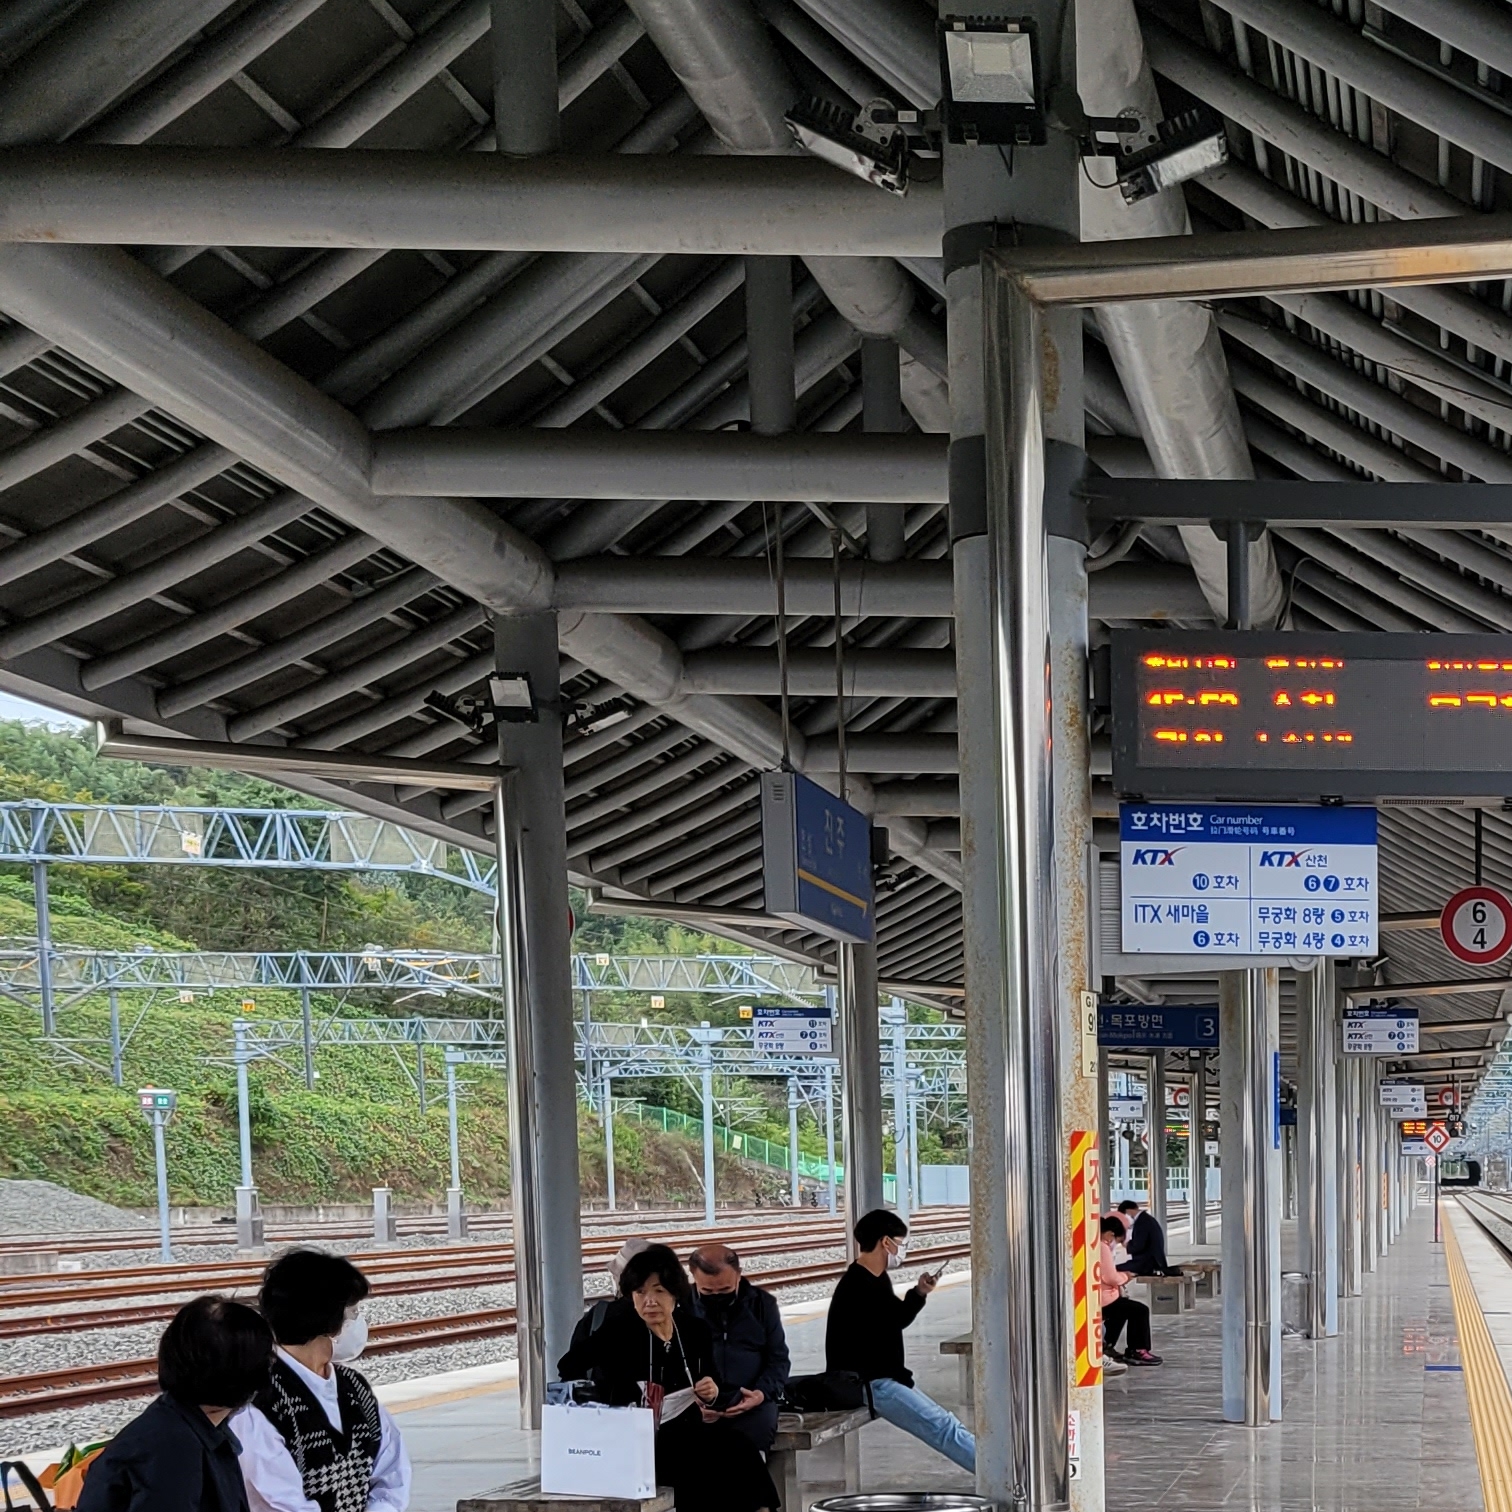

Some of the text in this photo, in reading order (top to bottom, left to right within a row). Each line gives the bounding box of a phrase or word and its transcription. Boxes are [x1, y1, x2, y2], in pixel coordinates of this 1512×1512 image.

[1130, 811, 1205, 834] 호차번호
[1209, 814, 1263, 826] Car number
[1132, 846, 1187, 866] KTX
[1259, 848, 1328, 868] KTX 산천
[1194, 875, 1239, 890] 10 호차
[1306, 876, 1369, 892] 6 7 호차
[1134, 904, 1209, 924] ITX 새마을
[1258, 906, 1370, 925] 무궁화 8량 5 호차
[1472, 901, 1487, 924] 6
[1196, 931, 1240, 947] 6 호차
[1258, 931, 1370, 950] 무궁화 4량 4 호차
[1472, 928, 1487, 950] 4
[757, 1020, 777, 1028] KTX
[1202, 1017, 1215, 1037] 3
[1347, 1021, 1366, 1029] KTX
[757, 1031, 777, 1039] KTX
[1347, 1032, 1366, 1040] KTX
[1432, 1134, 1441, 1143] 10
